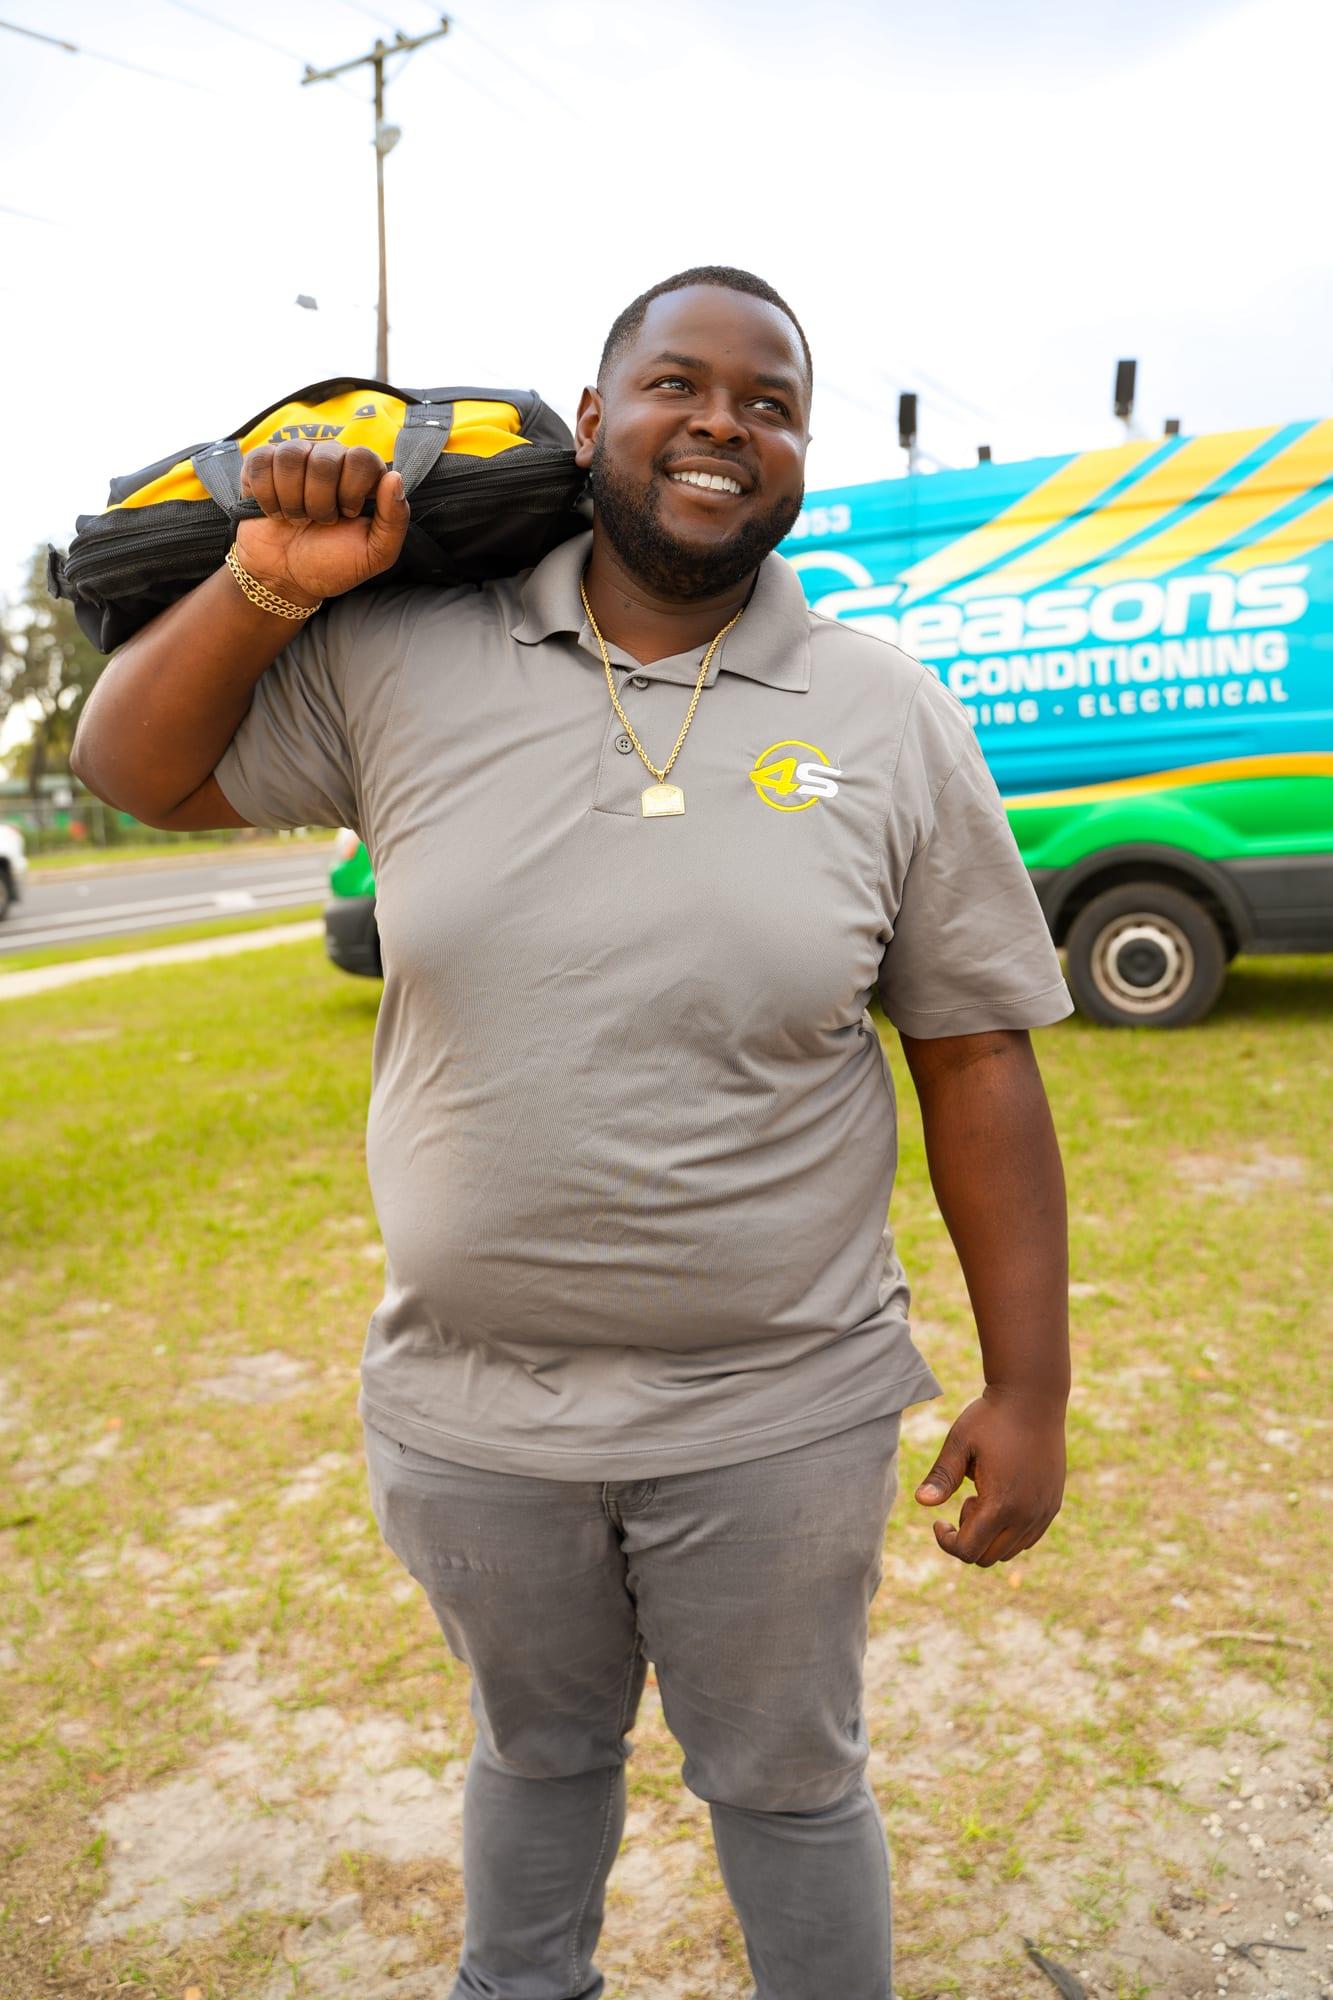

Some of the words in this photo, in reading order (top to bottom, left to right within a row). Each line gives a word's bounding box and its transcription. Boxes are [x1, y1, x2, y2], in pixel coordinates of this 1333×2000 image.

[947, 631, 1289, 698] CONDITIONING
[1079, 678, 1288, 718] ELECTRICAL
[749, 757, 842, 798] 4S
